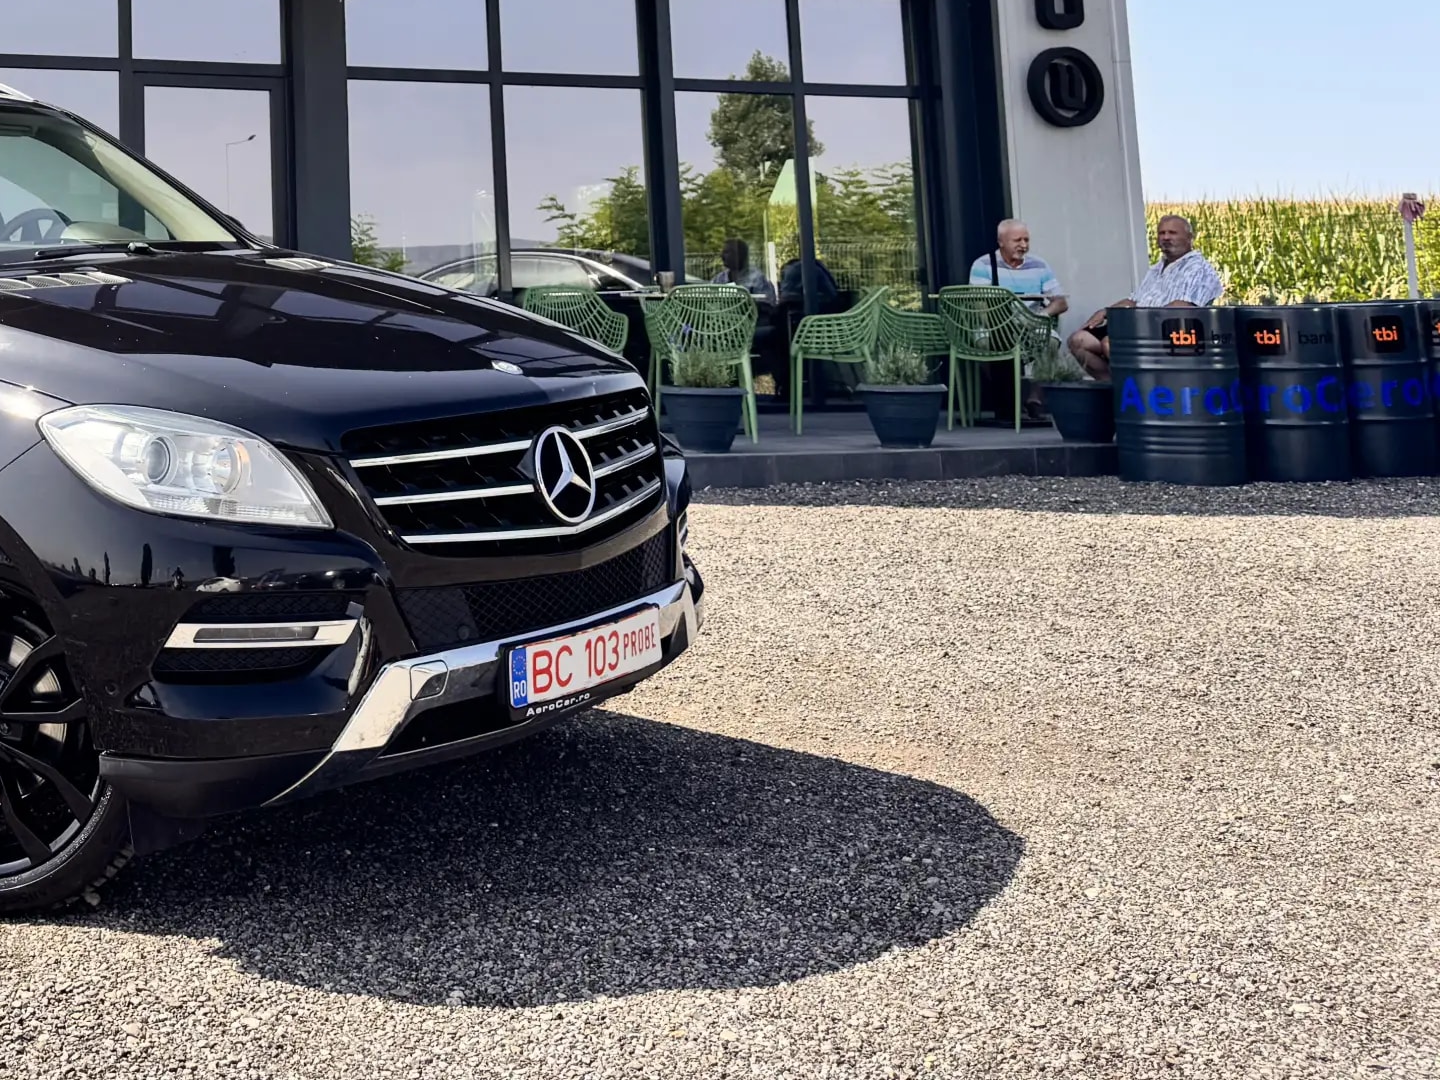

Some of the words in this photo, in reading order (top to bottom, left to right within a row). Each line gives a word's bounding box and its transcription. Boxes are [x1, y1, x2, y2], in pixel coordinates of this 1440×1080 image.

[1170, 329, 1197, 346] tbi
[1254, 329, 1281, 346] tbi
[1372, 322, 1399, 342] tbi
[532, 645, 573, 694] BC
[585, 630, 620, 678] 103
[623, 623, 657, 660] PROBE
[513, 681, 527, 699] RO
[526, 692, 591, 717] AeroCar.ro
